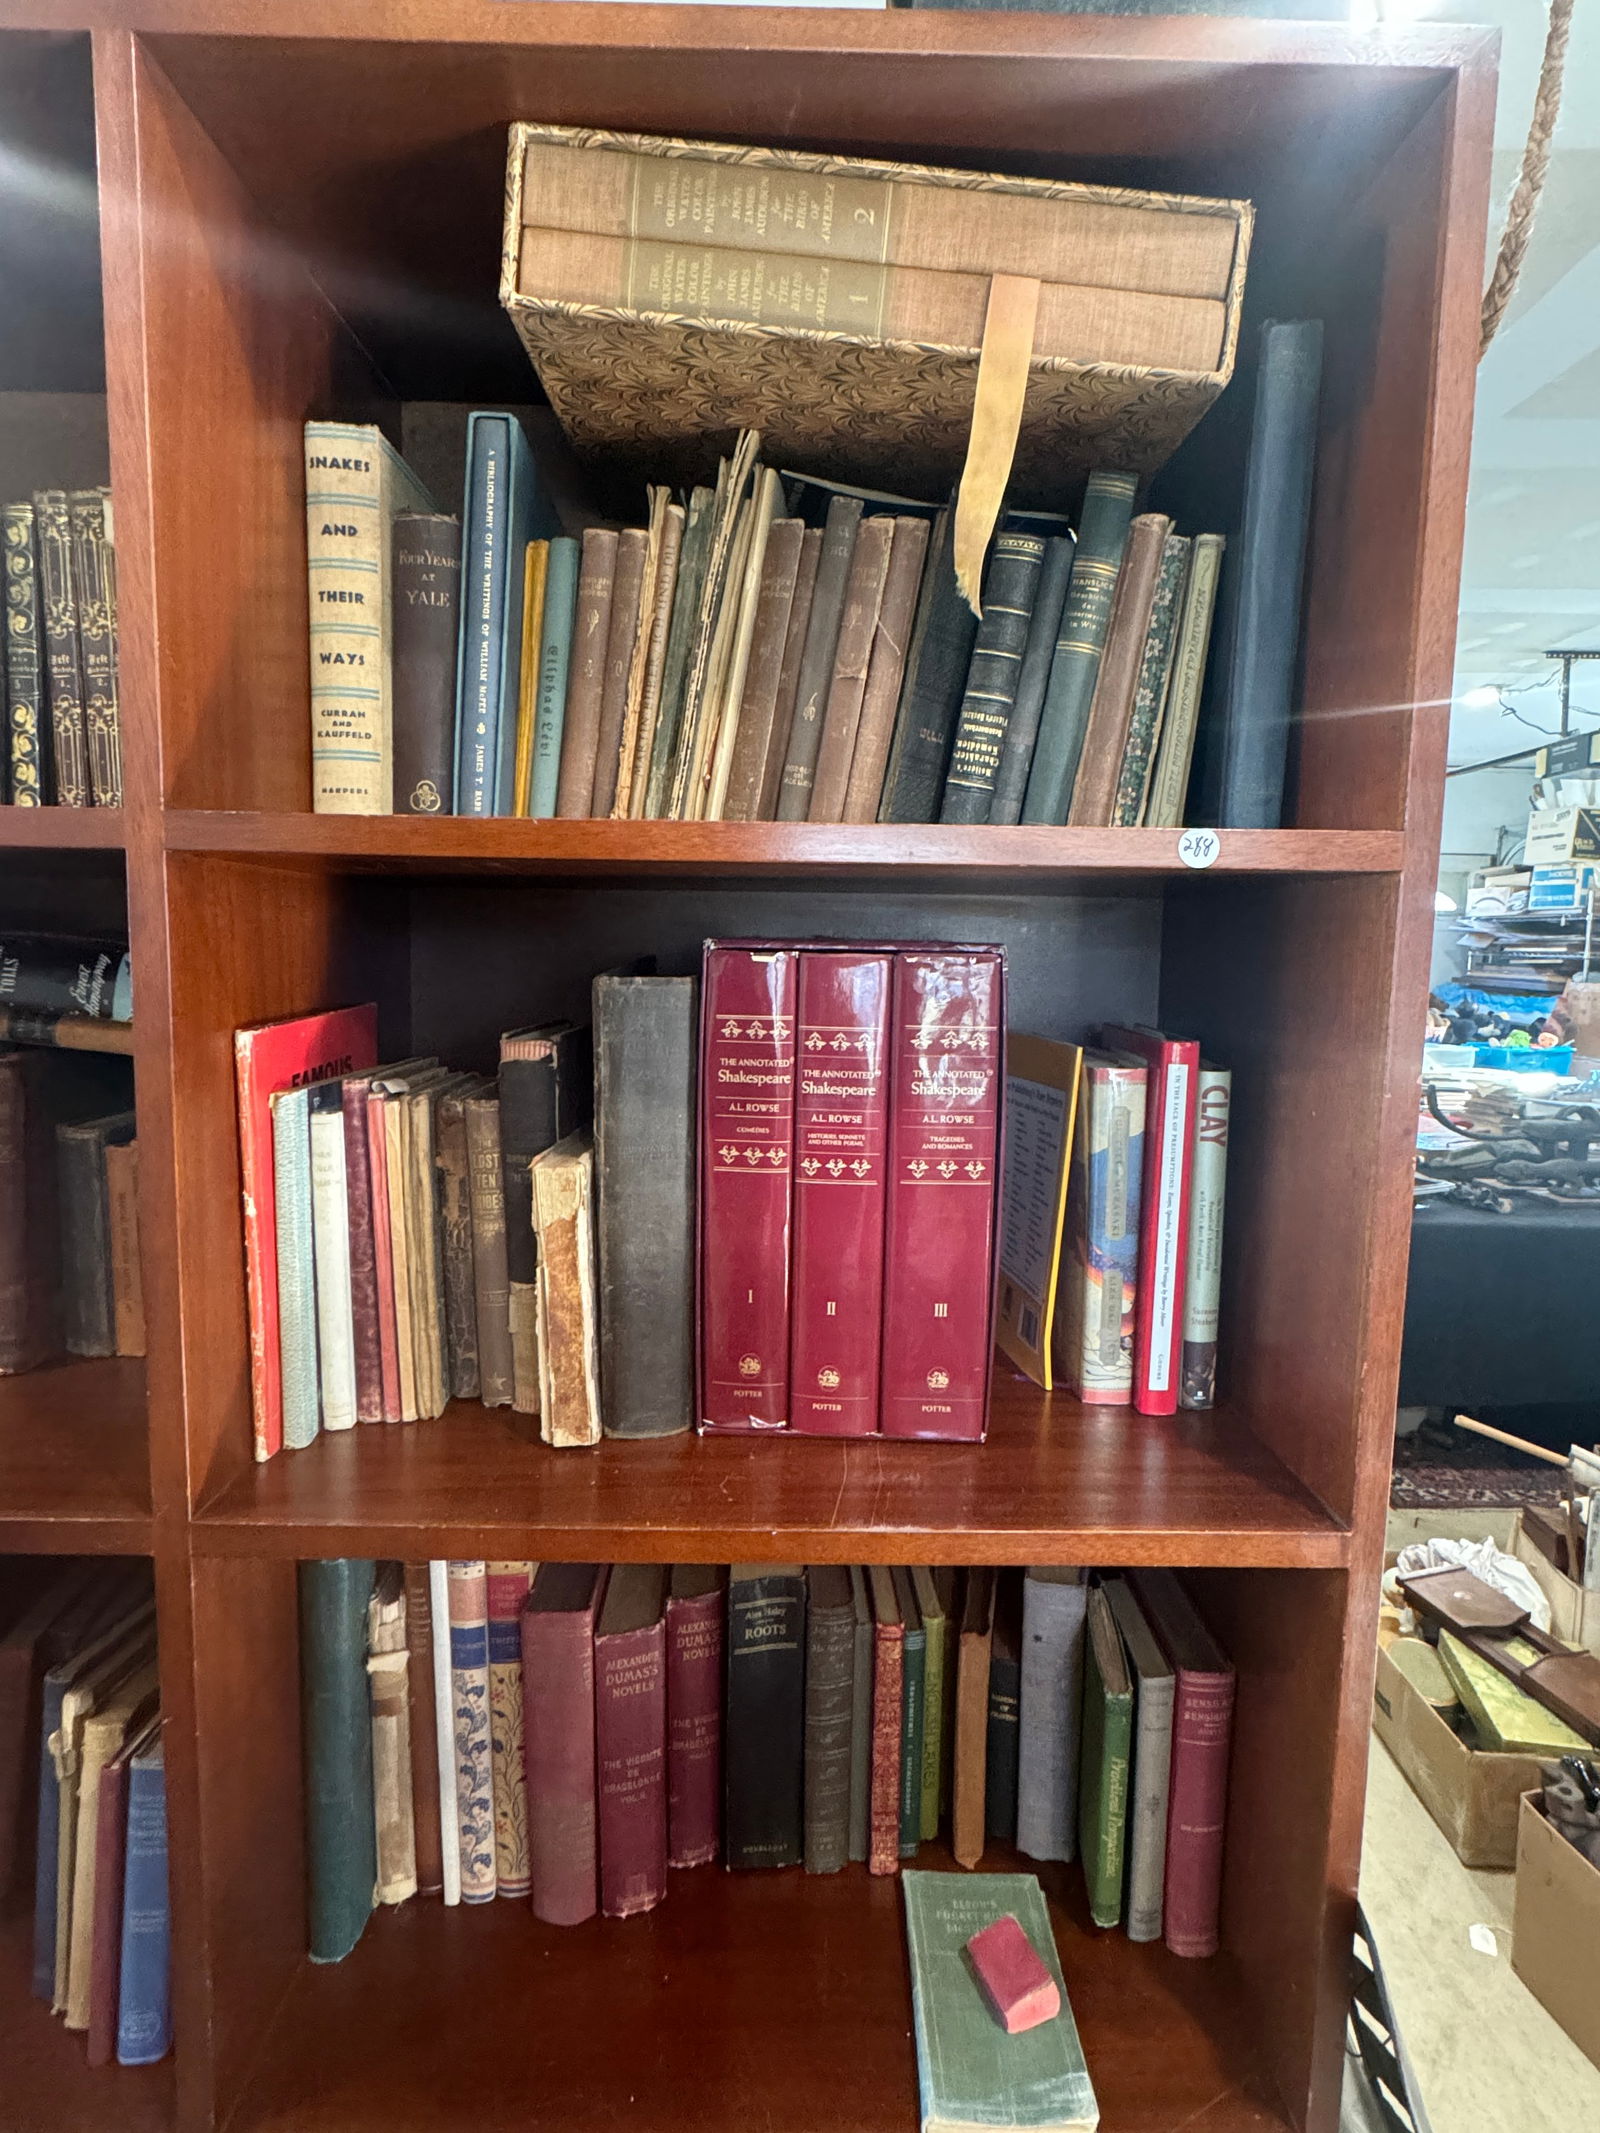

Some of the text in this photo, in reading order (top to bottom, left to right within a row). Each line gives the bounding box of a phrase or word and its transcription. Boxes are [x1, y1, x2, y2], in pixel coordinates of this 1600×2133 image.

[854, 208, 875, 226] 2
[850, 295, 868, 304] 1
[309, 456, 370, 473] SNAKES
[485, 461, 495, 529] BIBLIOGRAPHY
[320, 523, 359, 538] AND
[485, 533, 493, 546] OF
[399, 549, 425, 566] FOUR
[484, 550, 492, 569] THE
[421, 573, 435, 581] AT
[318, 591, 365, 605] THEIR
[406, 590, 450, 607] YALE
[482, 573, 491, 620] WRITINGS
[481, 623, 490, 636] OF
[319, 652, 365, 667] WAYS
[480, 641, 488, 681] WILLIAM
[321, 709, 366, 718] CURRAN
[317, 730, 372, 740] KAUFFELD
[475, 745, 484, 772] JAMES
[1183, 836, 1214, 857] 288
[69, 963, 92, 1004] Ernest
[83, 953, 112, 1018] Hemingway
[720, 1058, 790, 1068] THE ANNOTATED
[292, 1055, 353, 1088] FAMOUS
[718, 1069, 791, 1087] Shakespeare
[803, 1069, 874, 1080] THE ANNOTATED
[912, 1069, 985, 1080] THE ANNOTATED
[1175, 1075, 1182, 1083] IN
[801, 1081, 876, 1098] Shakespeare
[911, 1082, 986, 1098] Shakespeare
[746, 1104, 780, 1113] ROWSE
[828, 1114, 863, 1124] ROWSE
[939, 1115, 975, 1124] ROWSE
[1200, 1085, 1228, 1148] CLAY
[1172, 1123, 1178, 1132] OF
[936, 1143, 974, 1151] ROMANCES
[474, 1153, 500, 1170] LOST
[477, 1174, 497, 1188] TEN
[748, 1289, 753, 1303] I
[826, 1301, 836, 1316] II
[934, 1303, 948, 1317] III
[733, 1390, 762, 1398] POTTER
[812, 1402, 842, 1412] POTTER
[921, 1404, 952, 1413] POTTER
[745, 1609, 763, 1620] Alex
[745, 1624, 787, 1640] ROOTS
[606, 1651, 660, 1672] ALEXANDRE
[605, 1664, 659, 1686] DUMAS'S
[612, 1681, 655, 1699] NOVELS
[604, 1760, 622, 1769] THE
[626, 1748, 662, 1766] VICOMTE
[627, 1767, 639, 1778] DE
[1109, 1756, 1128, 1814] Practical
